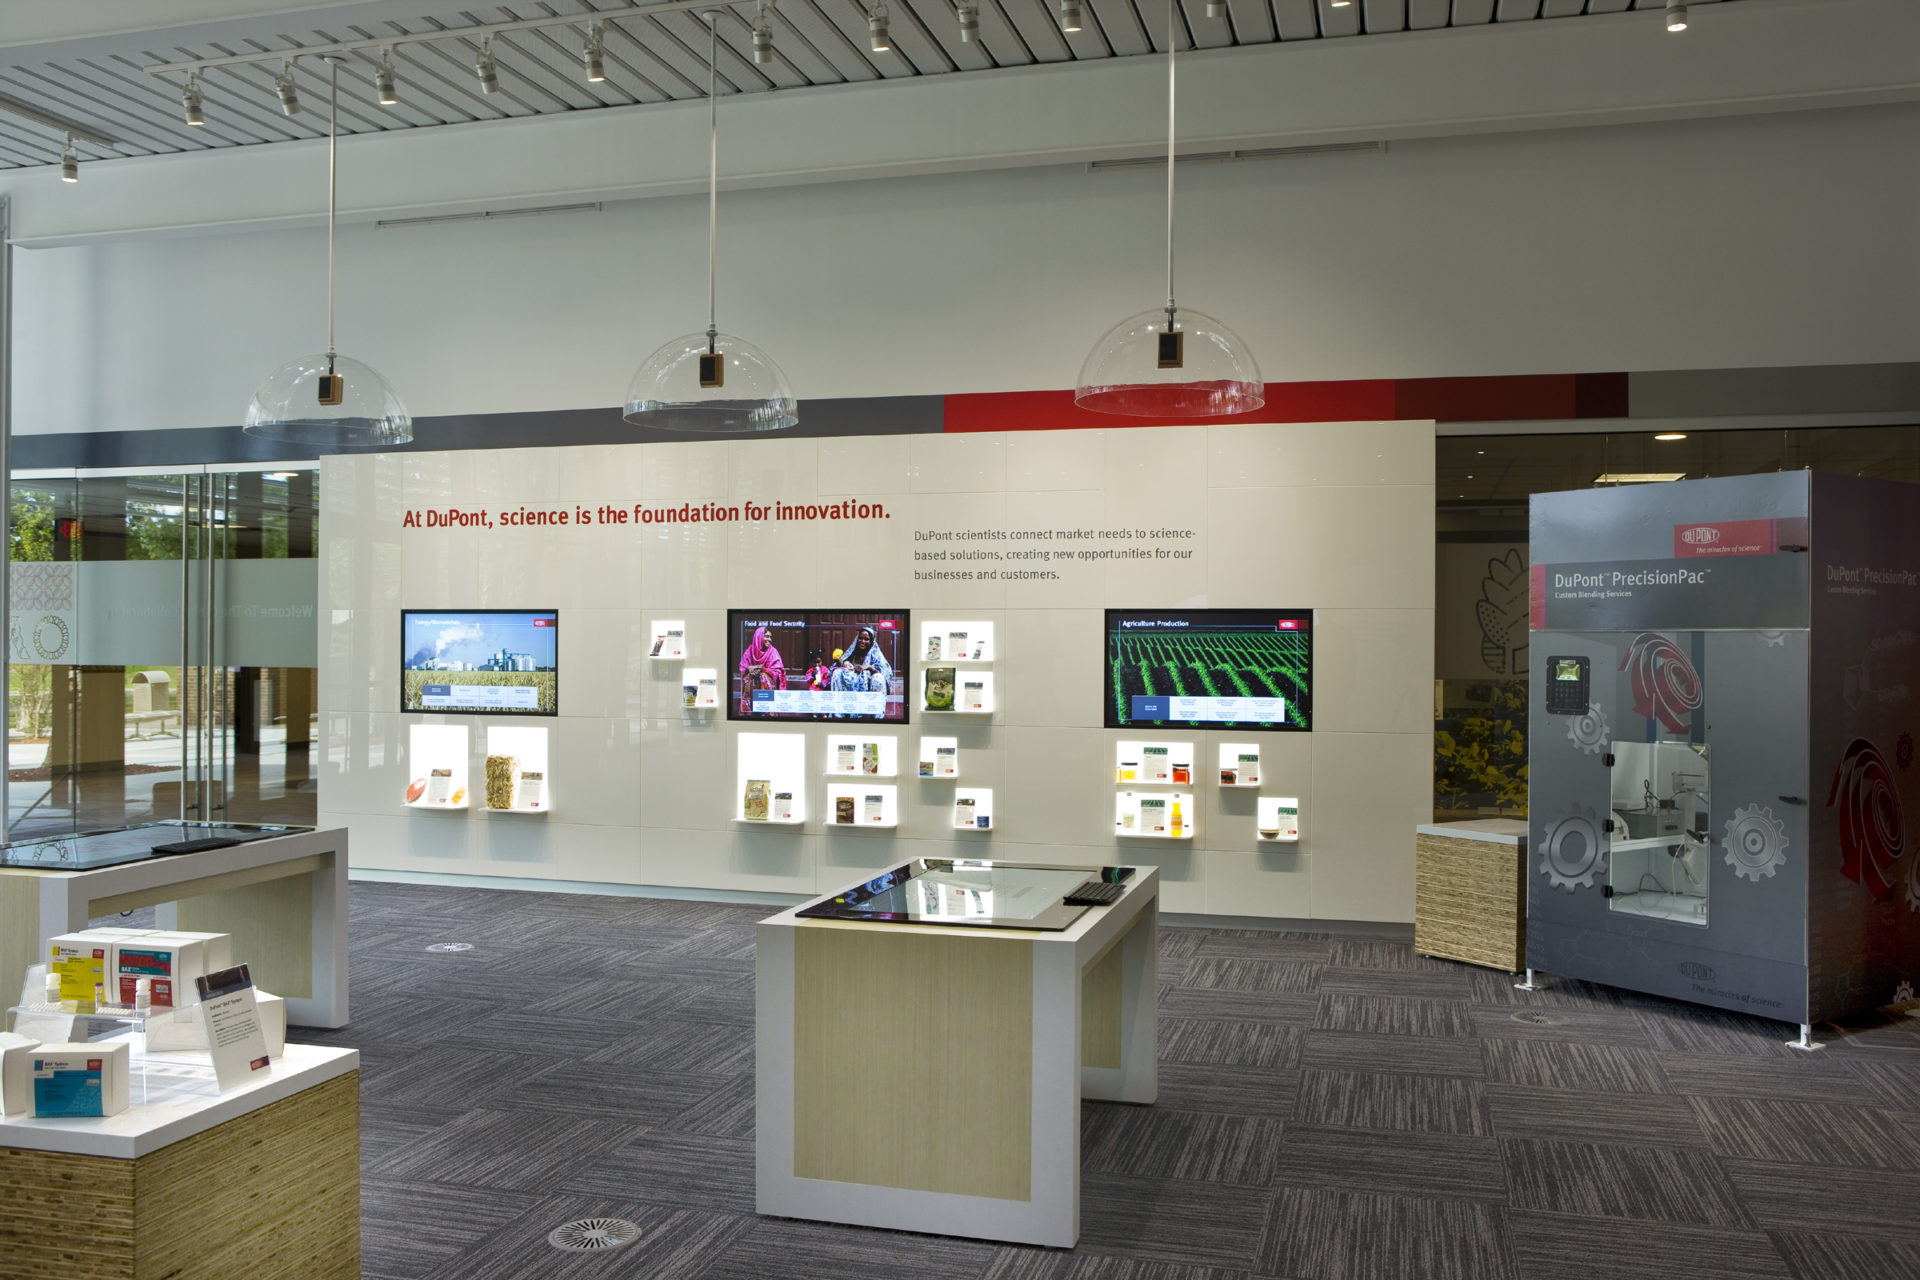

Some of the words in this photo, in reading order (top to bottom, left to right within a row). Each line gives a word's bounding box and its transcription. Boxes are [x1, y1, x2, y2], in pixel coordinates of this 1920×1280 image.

[403, 510, 422, 527] At
[427, 509, 493, 529] DuPont,
[500, 507, 569, 526] science
[576, 506, 591, 525] is
[598, 505, 628, 524] the
[634, 502, 739, 524] foundation
[745, 501, 771, 521] for
[776, 499, 890, 520] innovation.
[914, 530, 952, 541] DuPont
[956, 530, 1007, 541] scientists
[1010, 530, 1053, 540] connect
[1056, 529, 1094, 540] market
[1098, 528, 1132, 539] needs
[1135, 529, 1146, 539] to
[1150, 528, 1196, 539] science-
[914, 550, 946, 561] based
[950, 550, 1003, 562] solutions,
[1006, 549, 1050, 562] creating
[1053, 550, 1075, 560] new
[1078, 548, 1152, 562] opportunities
[1155, 548, 1171, 559] for
[1173, 550, 1193, 560] our
[914, 569, 973, 580] businesses
[976, 570, 997, 580] and
[1000, 569, 1060, 580] customers.
[1555, 591, 1577, 599] Custom
[1579, 590, 1605, 600] Blending
[1606, 590, 1632, 598] Services
[784, 620, 806, 628] Security
[1123, 620, 1155, 628] Agriculture
